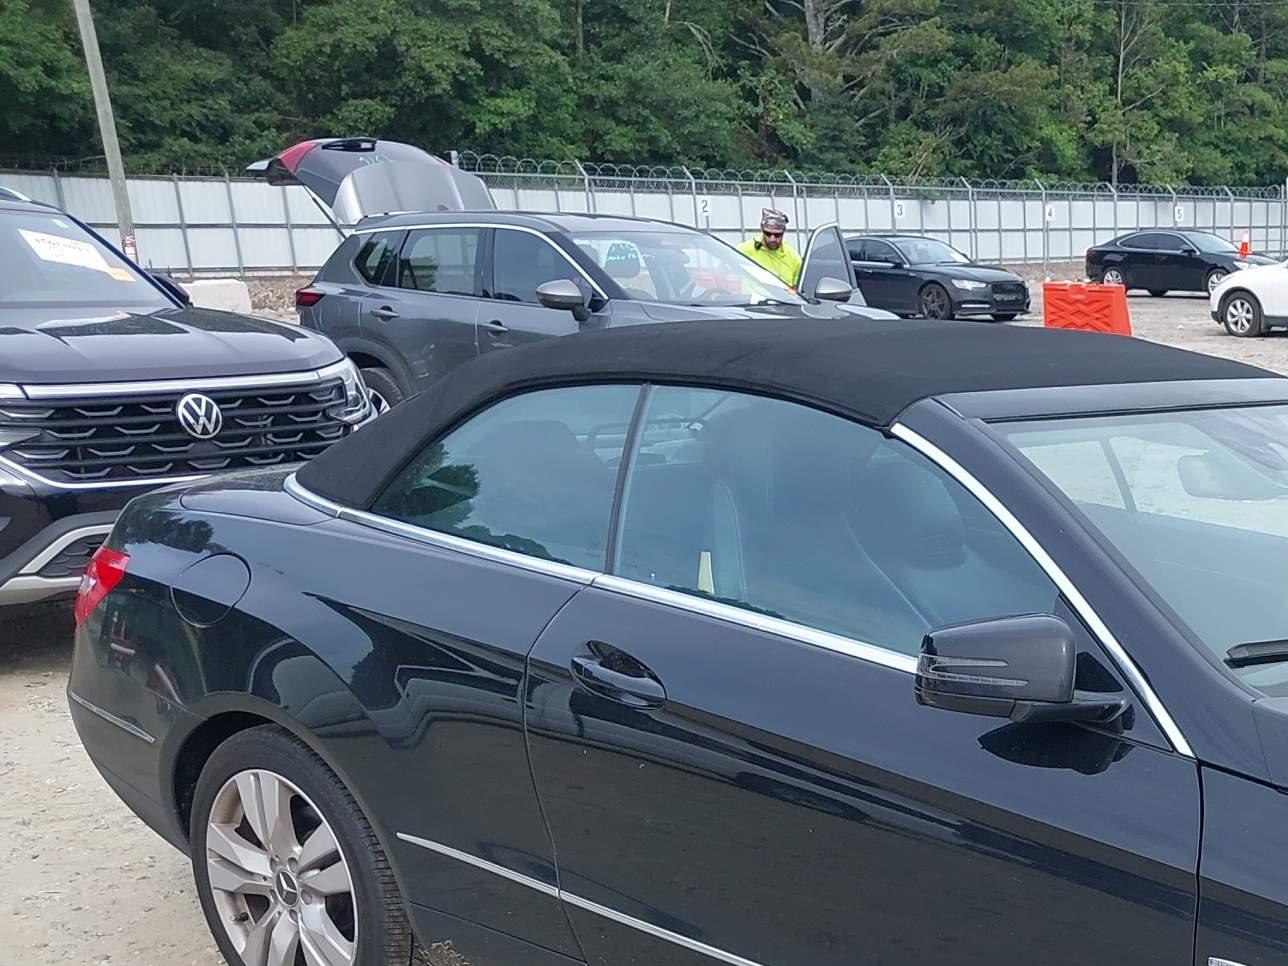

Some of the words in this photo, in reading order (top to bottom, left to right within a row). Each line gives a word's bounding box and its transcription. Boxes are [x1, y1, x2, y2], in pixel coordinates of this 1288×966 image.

[701, 199, 708, 213] 2
[897, 204, 903, 216] 3
[1047, 206, 1053, 219] 4
[1177, 207, 1183, 220] 5
